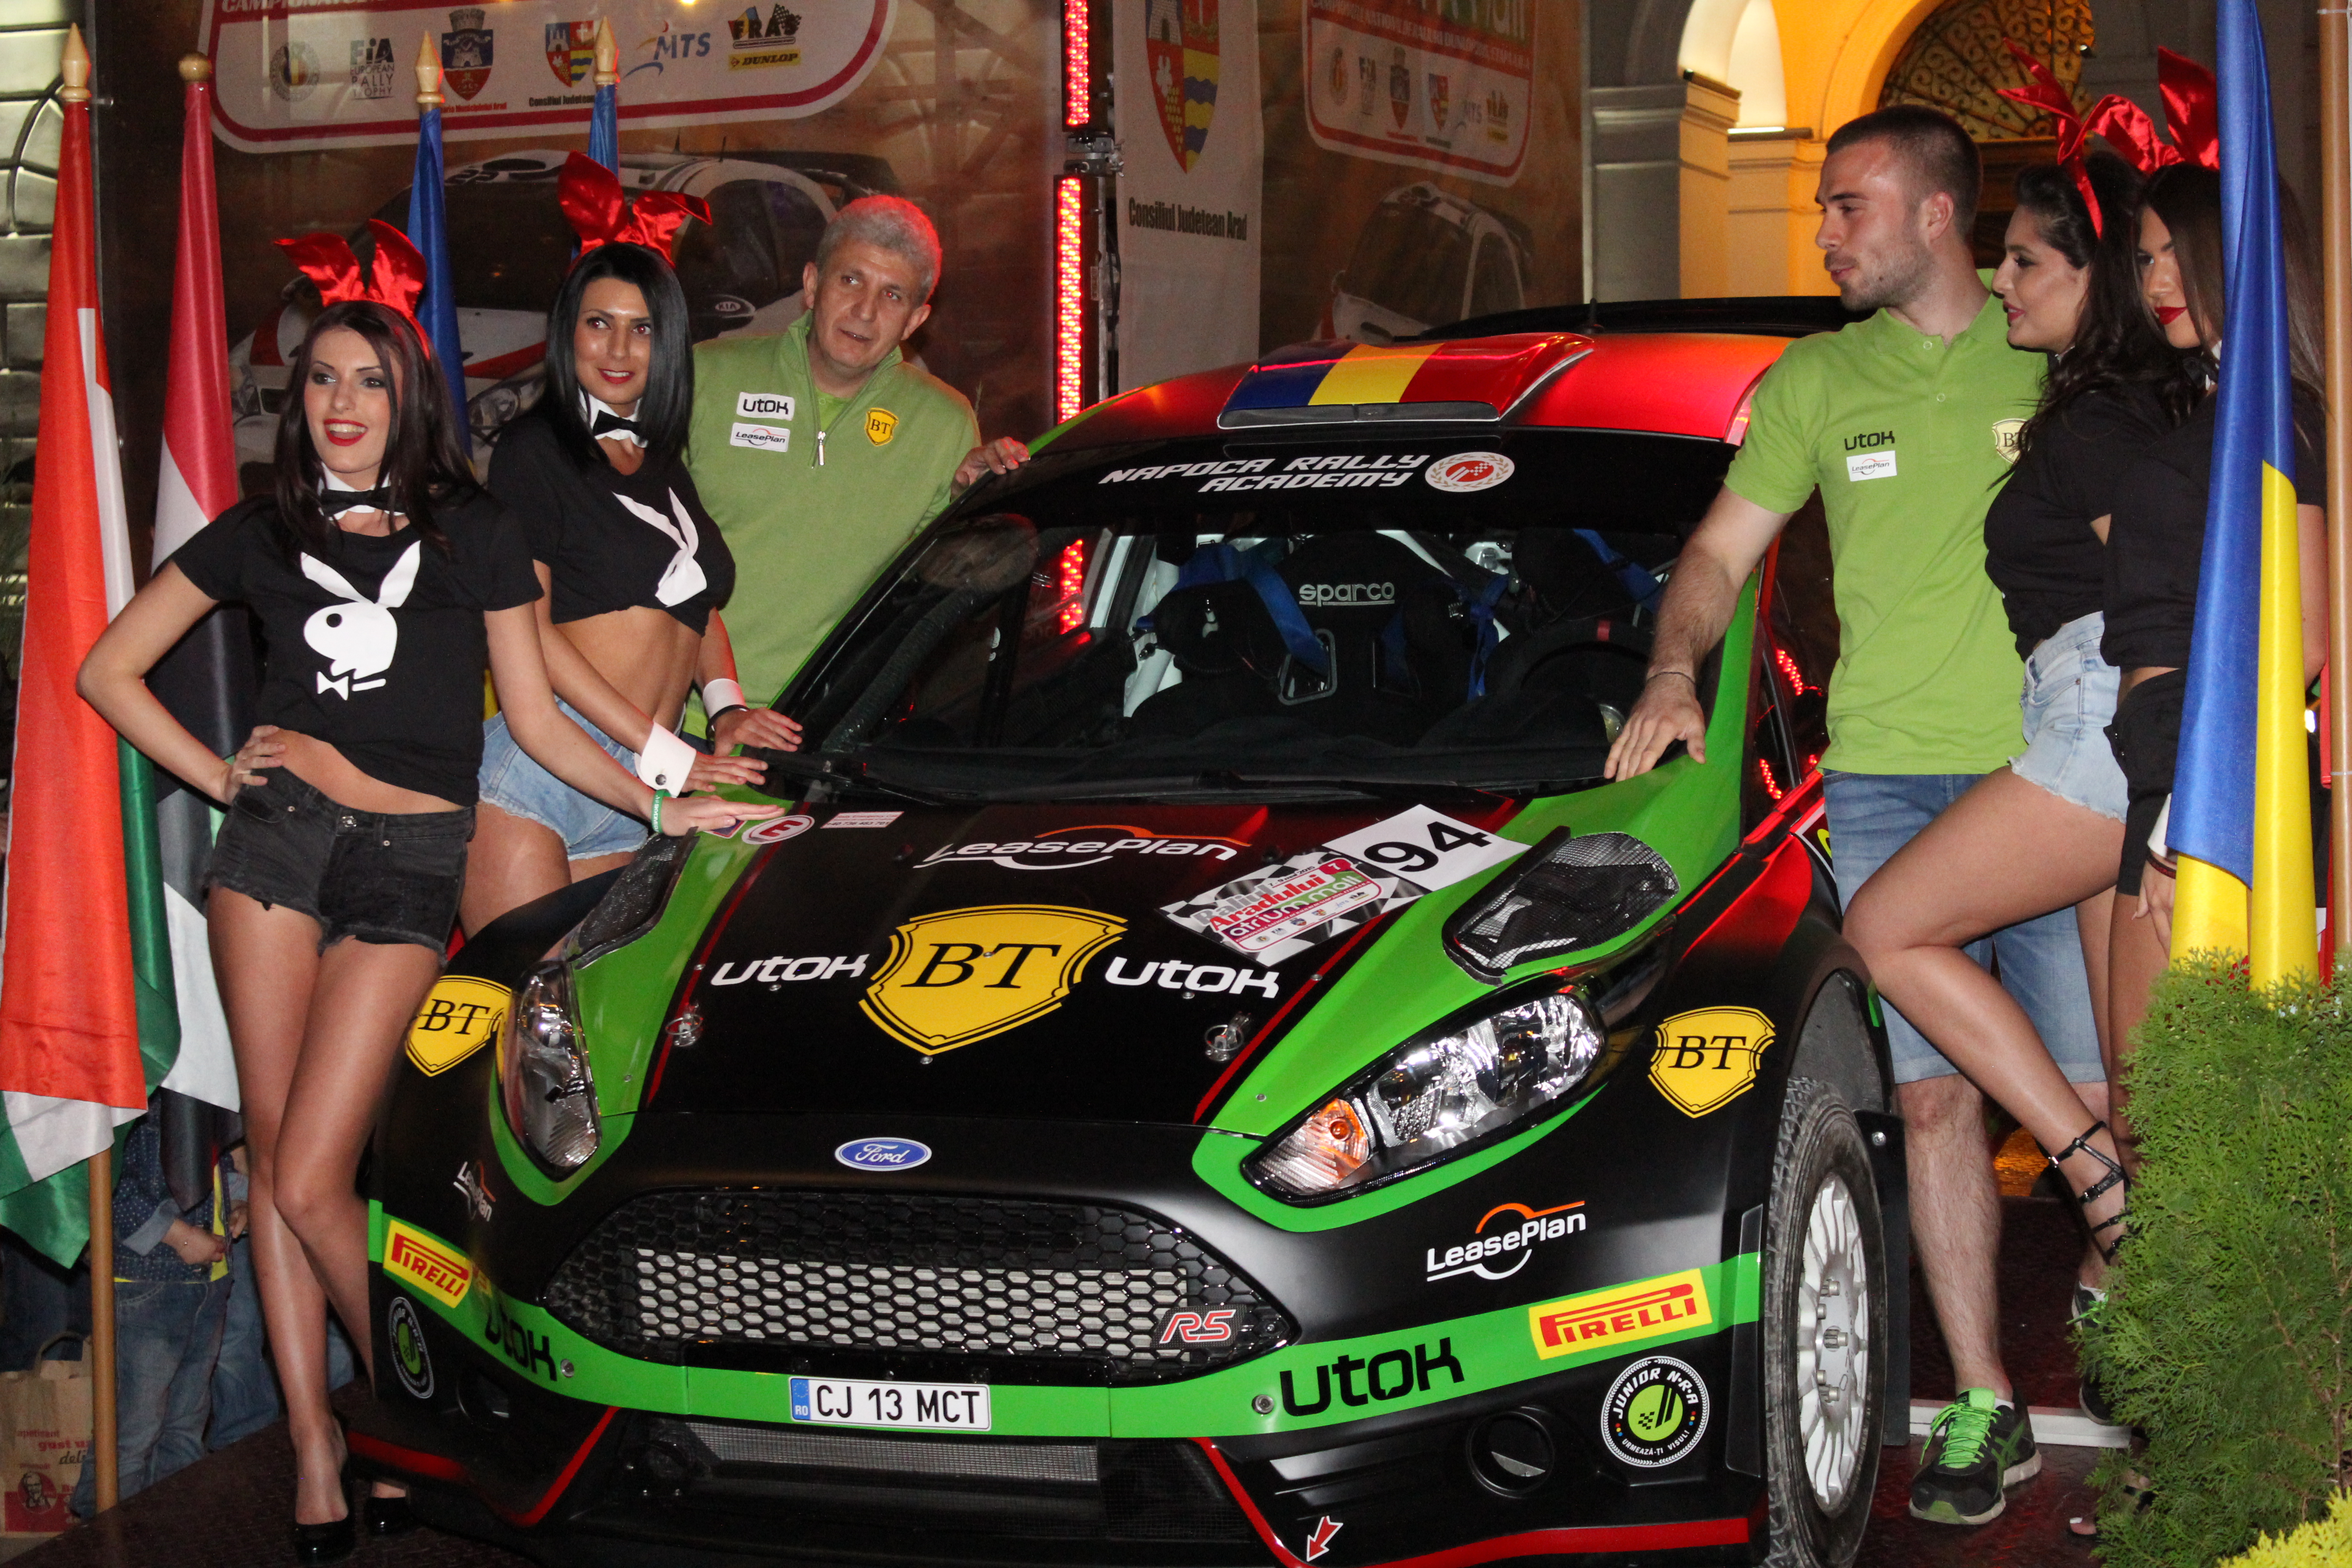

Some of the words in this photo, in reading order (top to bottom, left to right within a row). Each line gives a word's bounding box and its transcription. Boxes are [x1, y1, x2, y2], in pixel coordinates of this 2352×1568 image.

[654, 32, 710, 60] MTS
[742, 54, 798, 65] DUNLOP
[353, 87, 392, 97] TOPHY
[529, 97, 561, 107] Consiliul
[1129, 197, 1176, 231] Consiliul
[1226, 211, 1247, 241] Arad
[735, 431, 786, 443] LeasePlan
[871, 419, 891, 435] BT
[1098, 459, 1274, 484] NAPOCA
[1283, 455, 1431, 471] RALLY
[1197, 472, 1414, 493] ACADEMY
[1852, 461, 1890, 472] LeasePlan
[1299, 582, 1395, 607] sparco
[922, 839, 1238, 861] LeasePlan
[1364, 821, 1492, 872] 94
[1193, 884, 1275, 925] Raliul
[1210, 874, 1326, 931] Aradului
[1230, 900, 1309, 936] atrium
[1308, 875, 1362, 901] mall
[901, 943, 1062, 988] BT
[418, 999, 490, 1035] BT
[1668, 1035, 1747, 1070] BT
[854, 1142, 907, 1166] Ford
[1427, 1213, 1586, 1272] LeasePlan
[391, 1232, 469, 1296] PIRELLI
[1539, 1283, 1697, 1348] PIRELLI
[817, 1384, 852, 1418] CJ
[868, 1387, 903, 1421] 13
[917, 1389, 980, 1423] MCT
[1613, 1367, 1661, 1419] JUNIOR
[794, 1405, 808, 1416] RO
